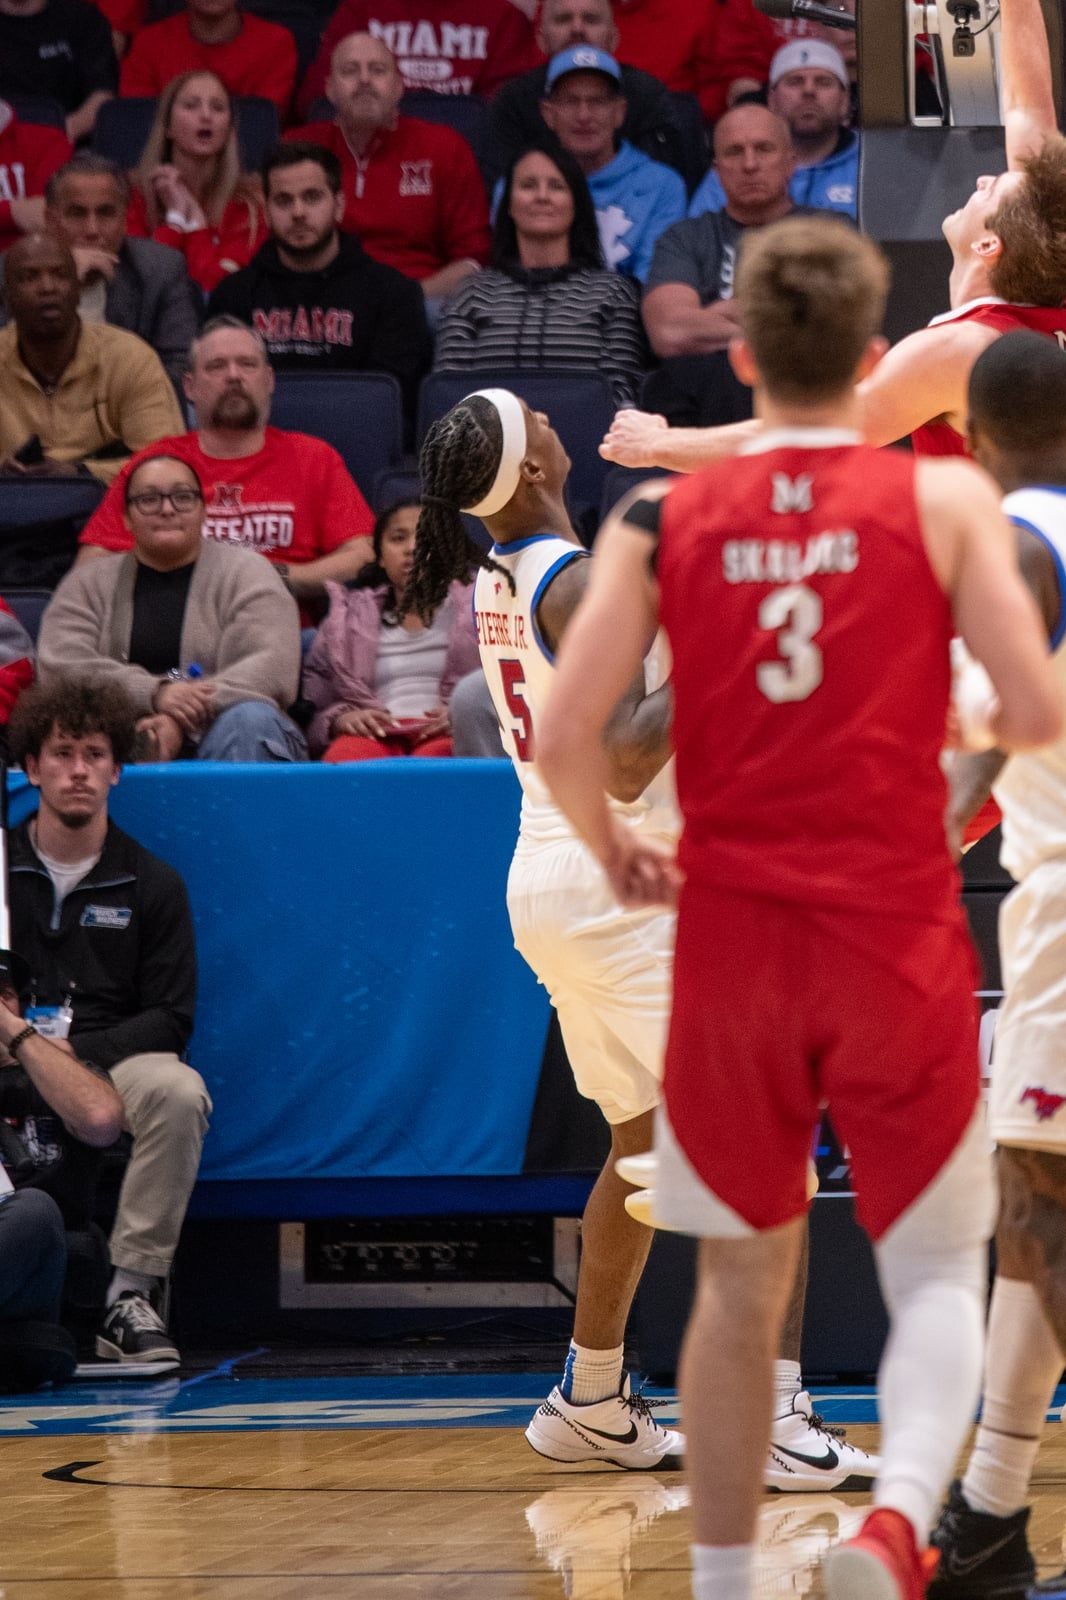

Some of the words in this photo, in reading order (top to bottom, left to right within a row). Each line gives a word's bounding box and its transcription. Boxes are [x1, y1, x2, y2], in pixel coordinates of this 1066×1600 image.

[368, 18, 489, 60] MIAMI
[252, 305, 355, 347] MIAMI
[771, 471, 815, 514] M
[202, 513, 294, 548] EFEATED
[475, 610, 512, 647] PIERRE
[513, 614, 529, 651] JR.
[757, 584, 824, 704] 3
[497, 658, 536, 763] 5
